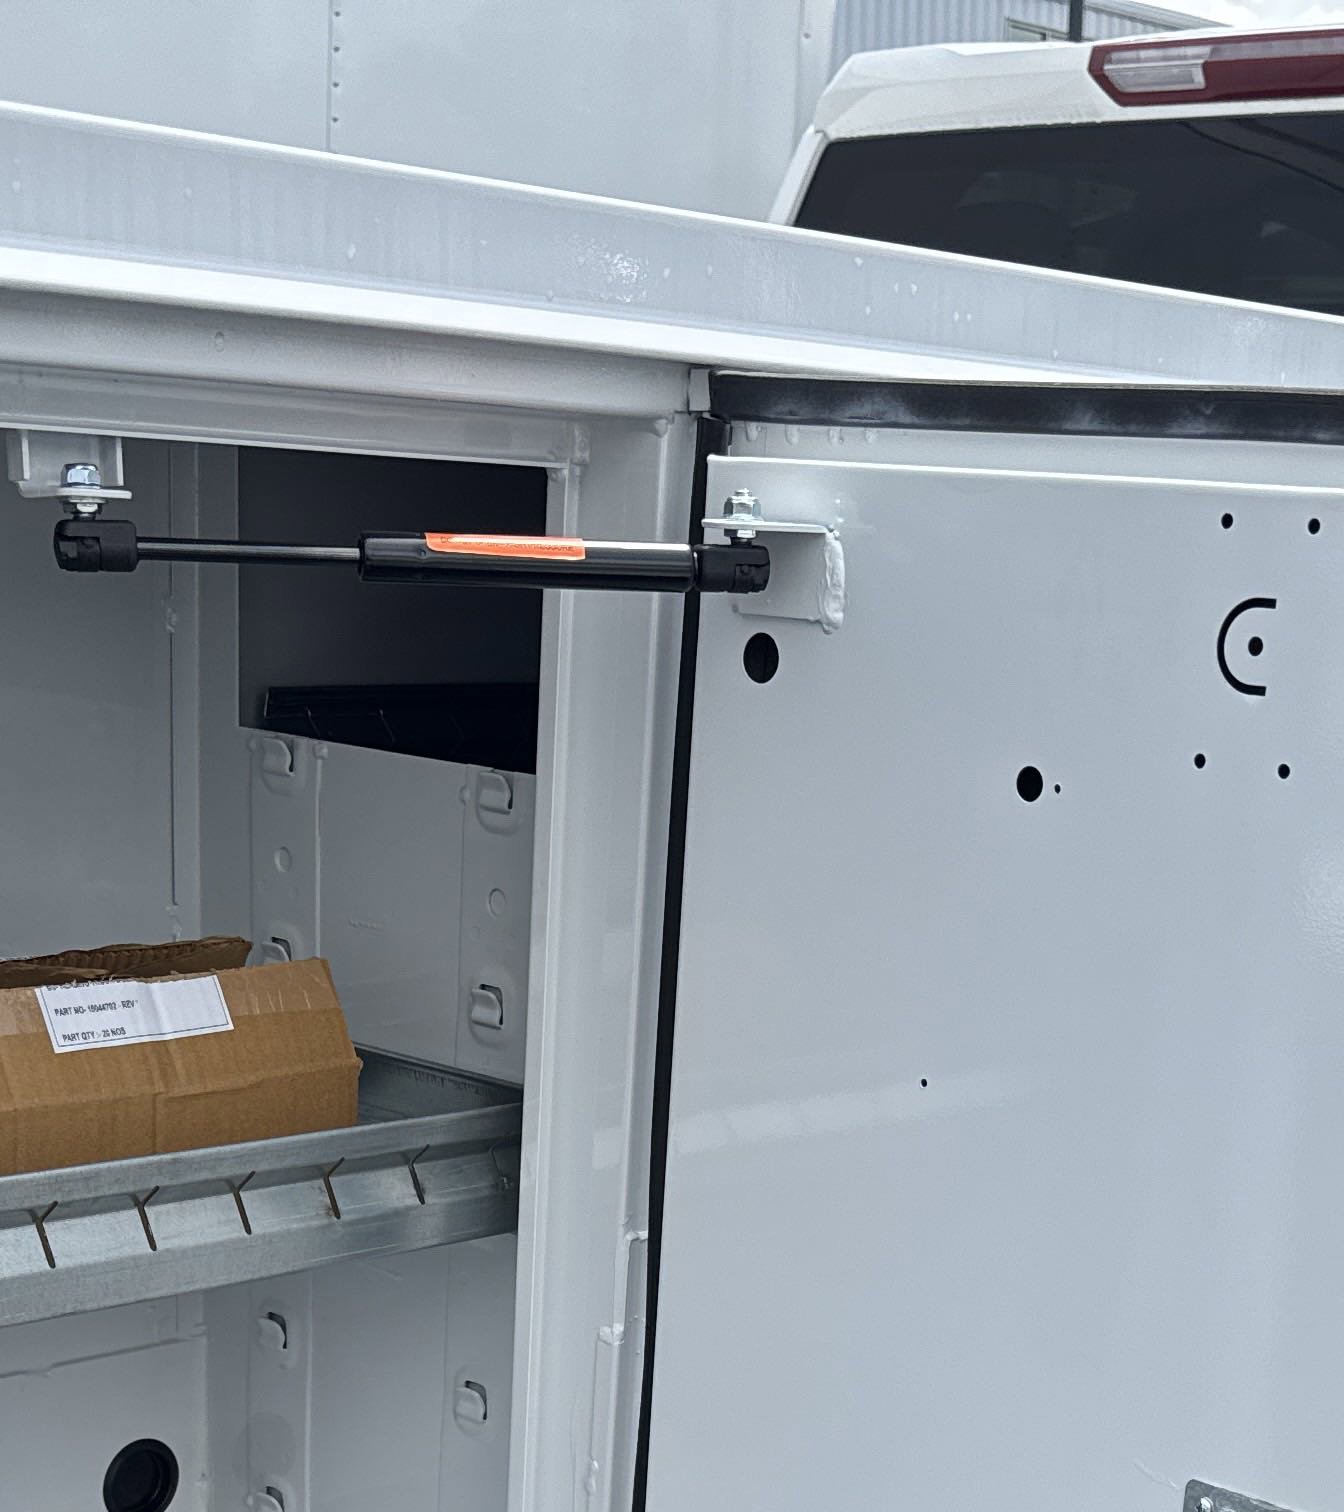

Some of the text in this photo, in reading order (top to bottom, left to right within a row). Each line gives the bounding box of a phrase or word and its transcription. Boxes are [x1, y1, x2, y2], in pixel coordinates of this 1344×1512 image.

[54, 1006, 72, 1017] PART
[62, 1032, 79, 1042] PART
[81, 1031, 96, 1041] QTY
